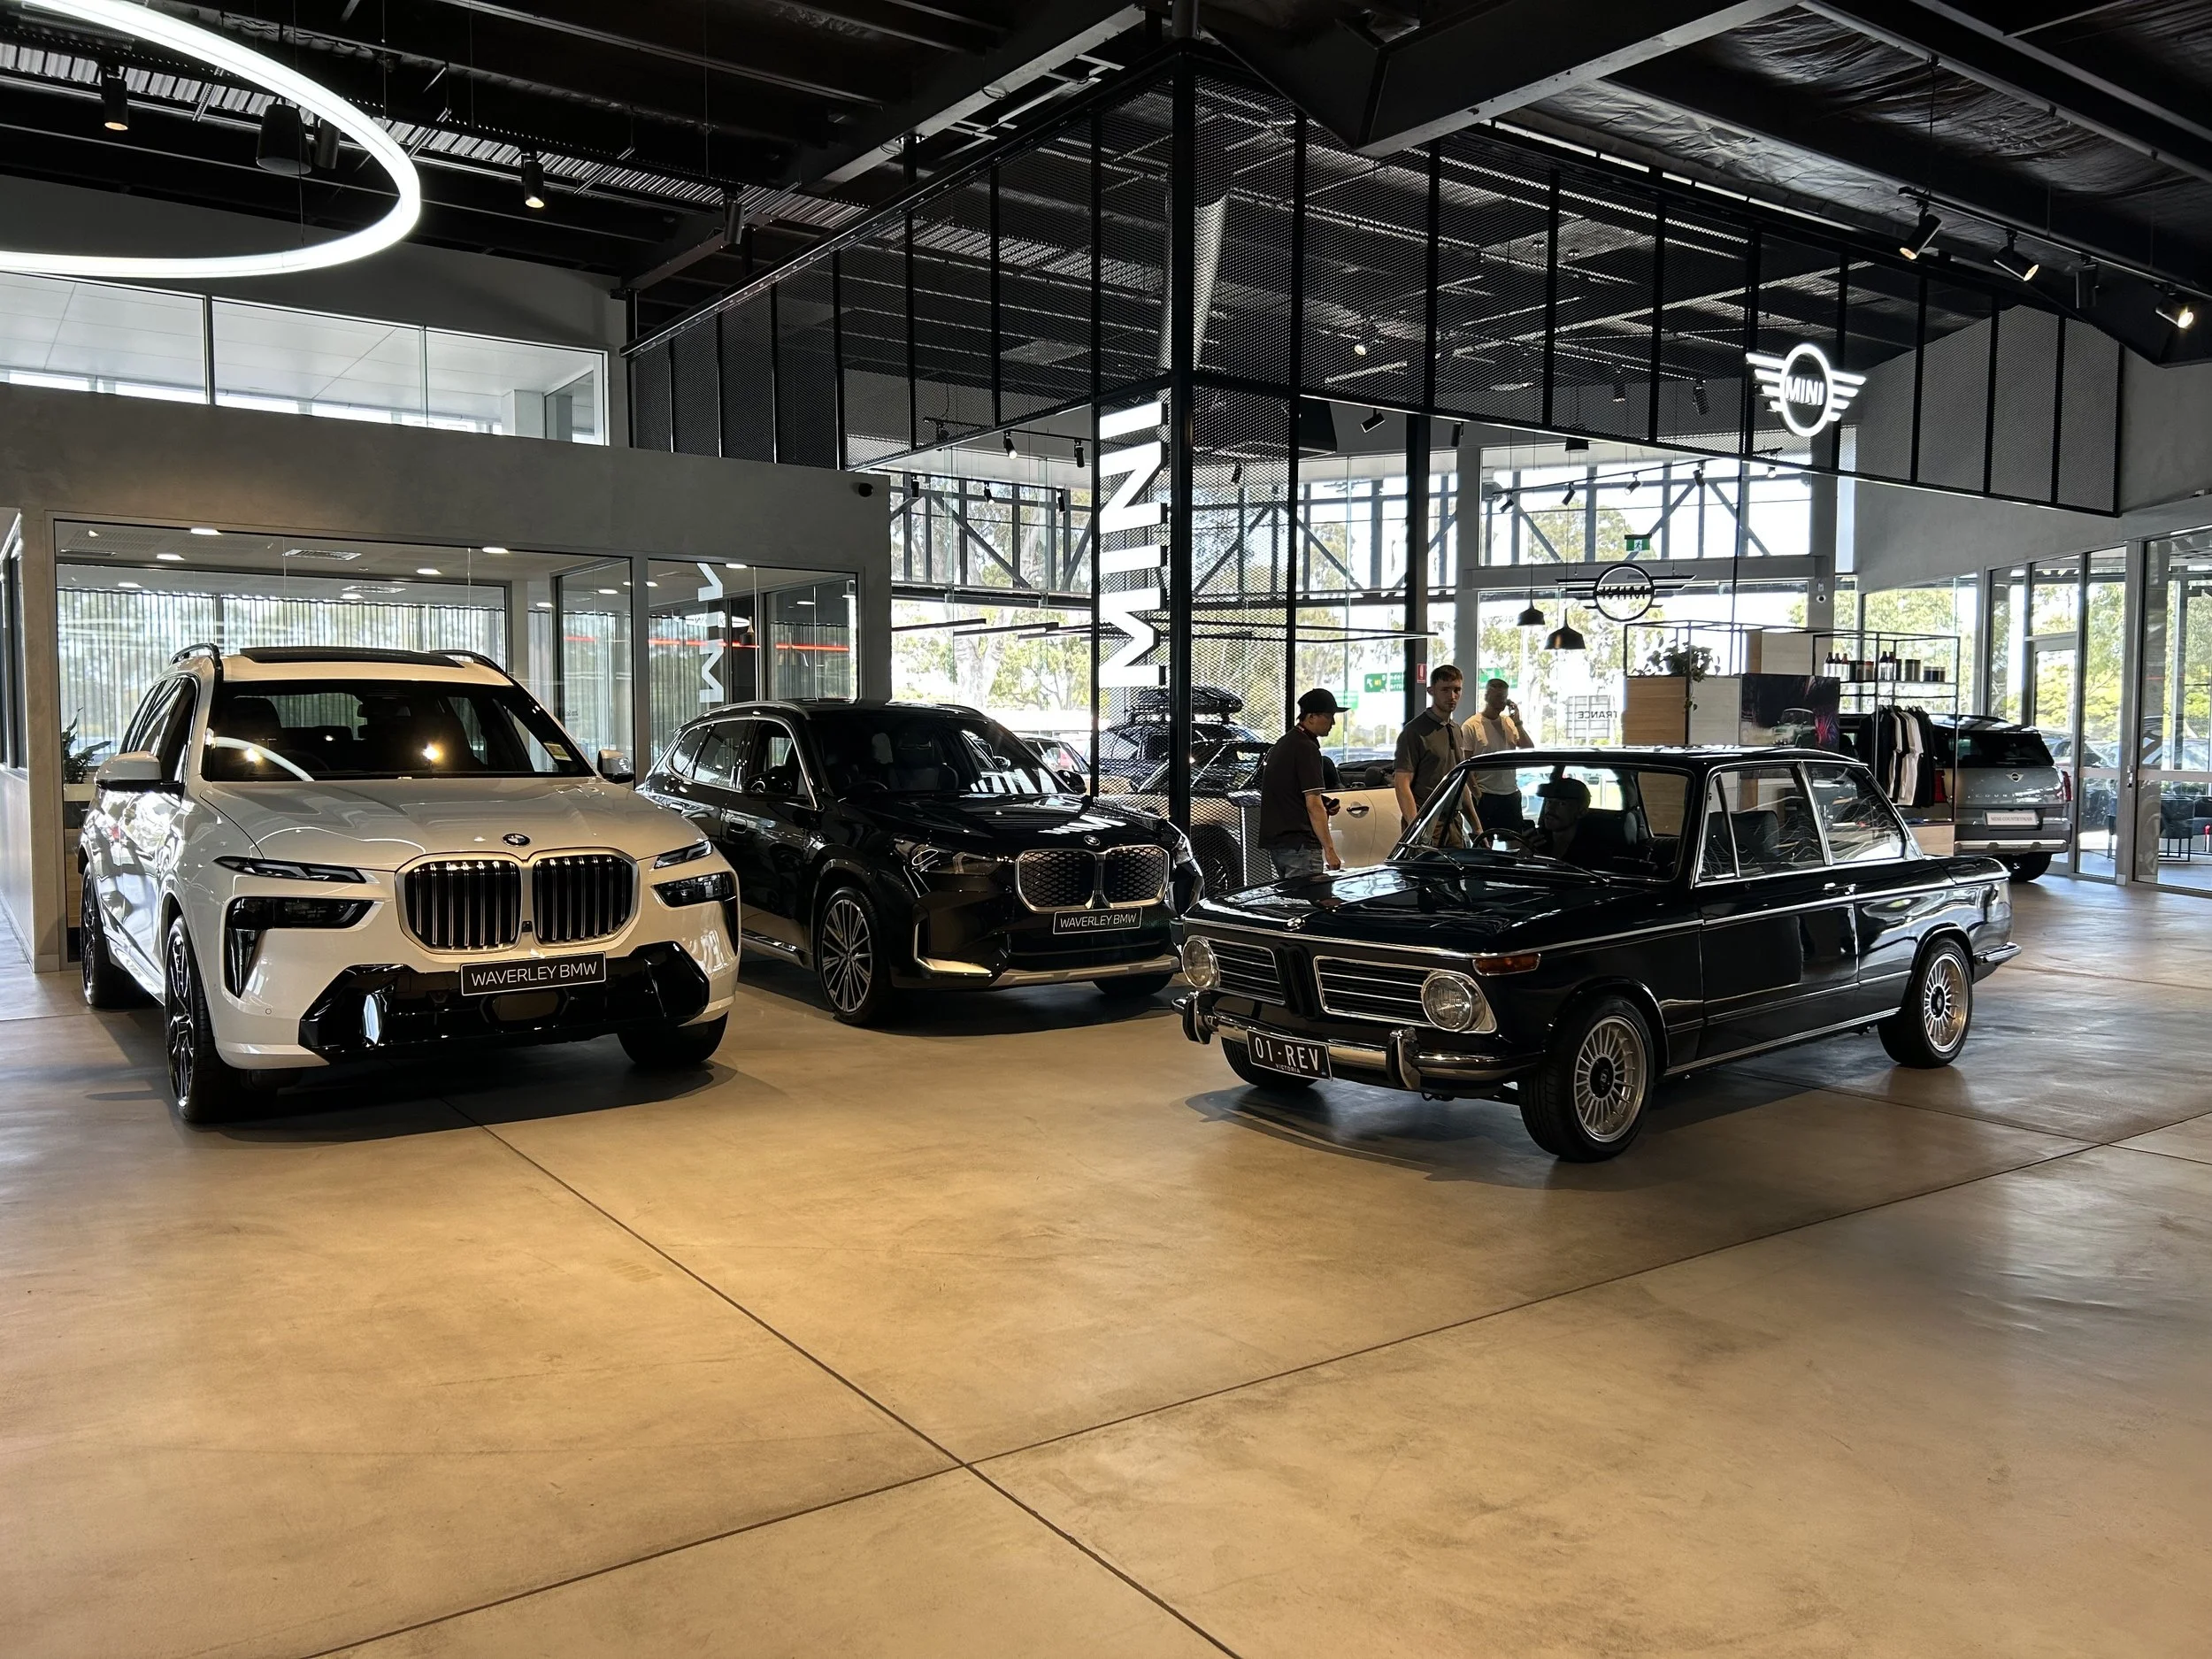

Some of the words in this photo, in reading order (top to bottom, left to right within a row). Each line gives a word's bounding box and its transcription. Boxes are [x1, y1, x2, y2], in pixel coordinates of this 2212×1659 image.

[1786, 376, 1824, 406] MINI
[1099, 401, 1164, 687] MINI
[1060, 915, 1113, 928] WAVERLEY
[1113, 913, 1137, 925] BMW
[471, 964, 557, 987] WAVERLEY
[560, 962, 597, 979] BMW
[1275, 1064, 1301, 1073] VICTORIA
